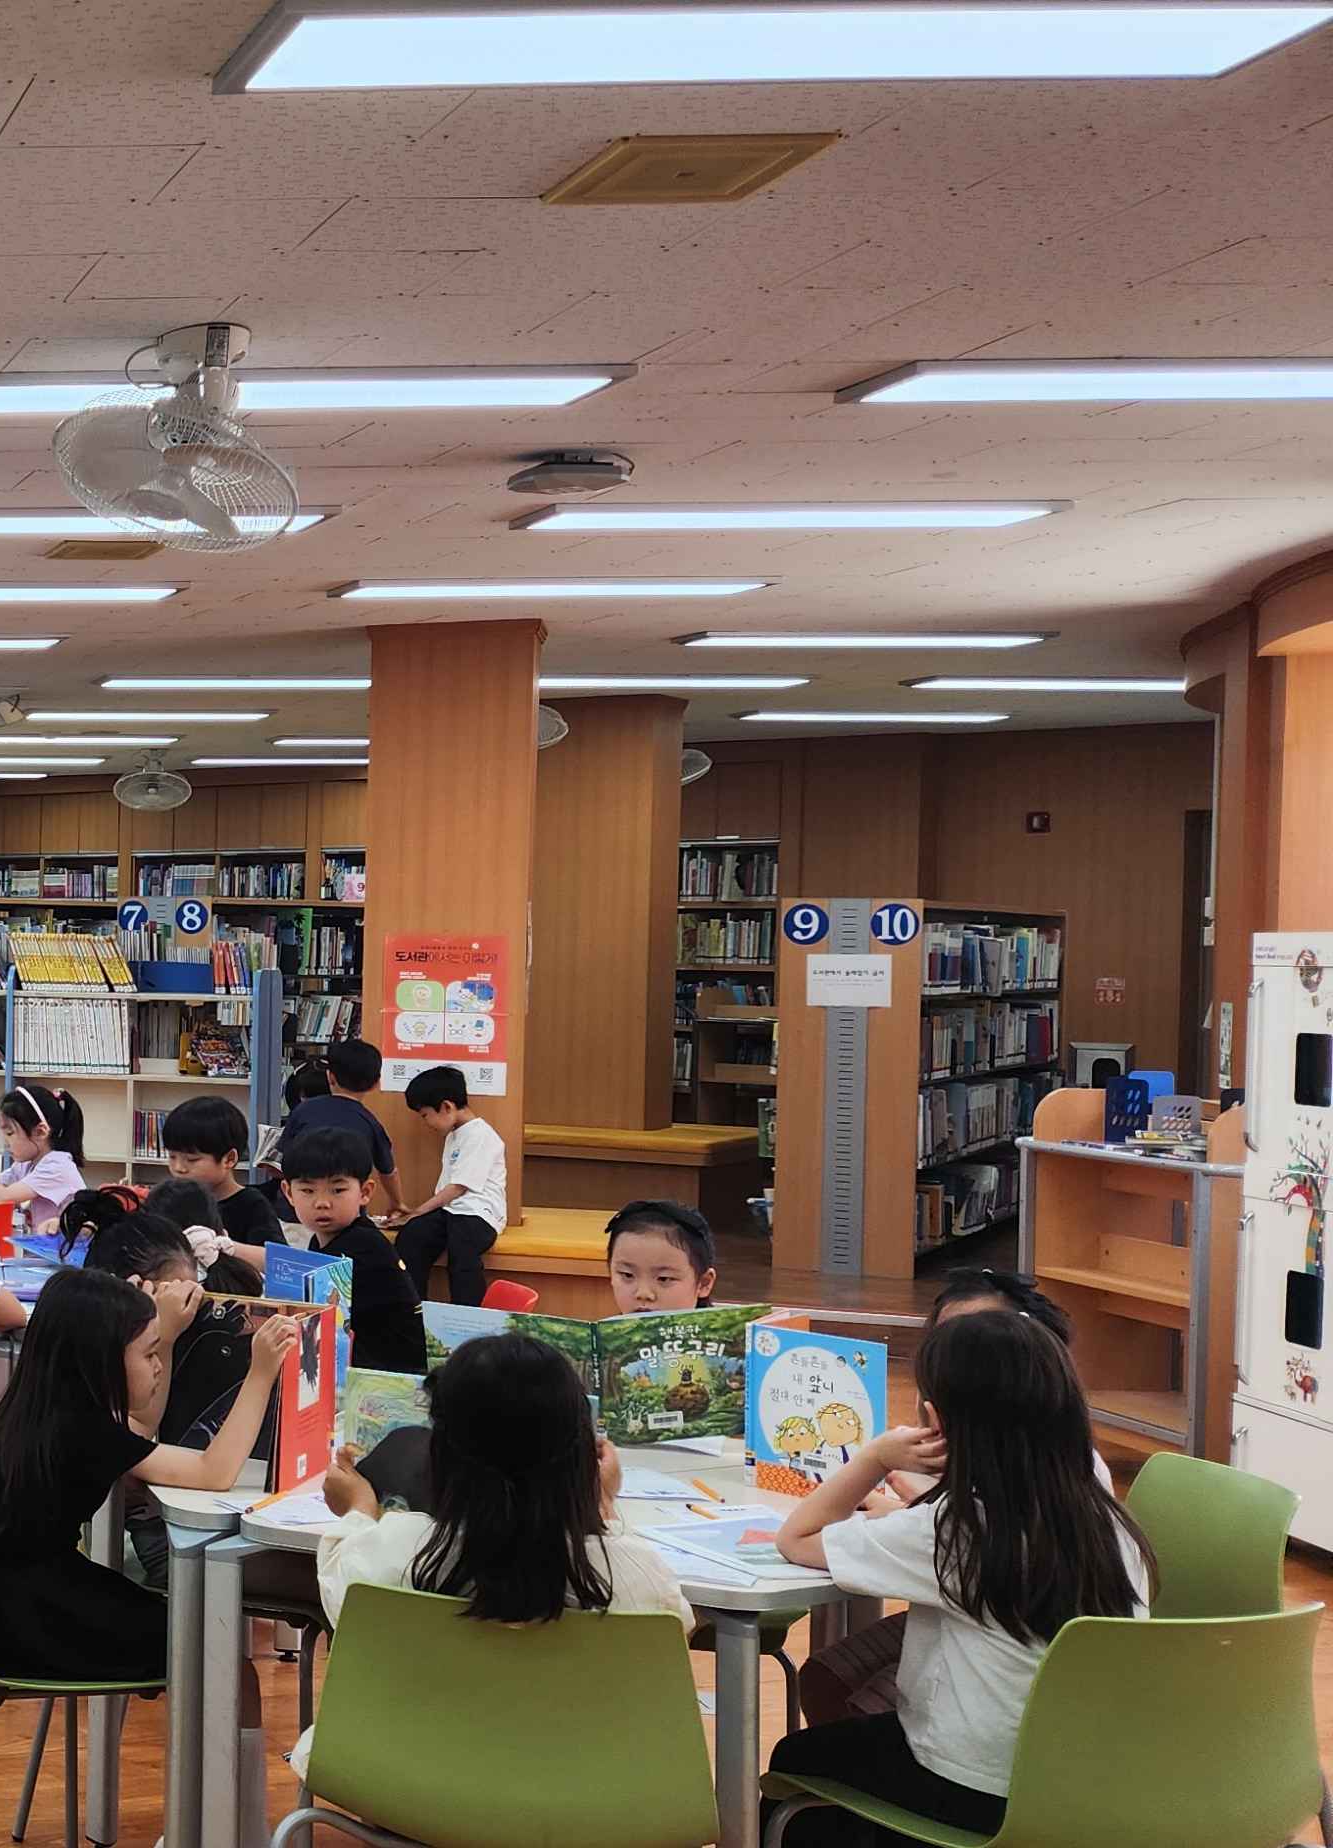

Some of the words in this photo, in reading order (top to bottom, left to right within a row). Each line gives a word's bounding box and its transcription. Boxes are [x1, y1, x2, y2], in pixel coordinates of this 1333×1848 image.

[123, 905, 144, 931] 7
[181, 903, 204, 931] 8
[792, 908, 820, 941] 9
[875, 907, 916, 941] 10
[395, 951, 461, 964] 도서관에서는
[658, 1324, 702, 1340] 행복한
[639, 1339, 726, 1369] 말똥구리
[790, 1352, 828, 1370] 흔들흔들
[793, 1373, 803, 1386] 내
[809, 1374, 835, 1395] 앞니
[769, 1387, 790, 1403] 절대
[793, 1393, 804, 1408] 안
